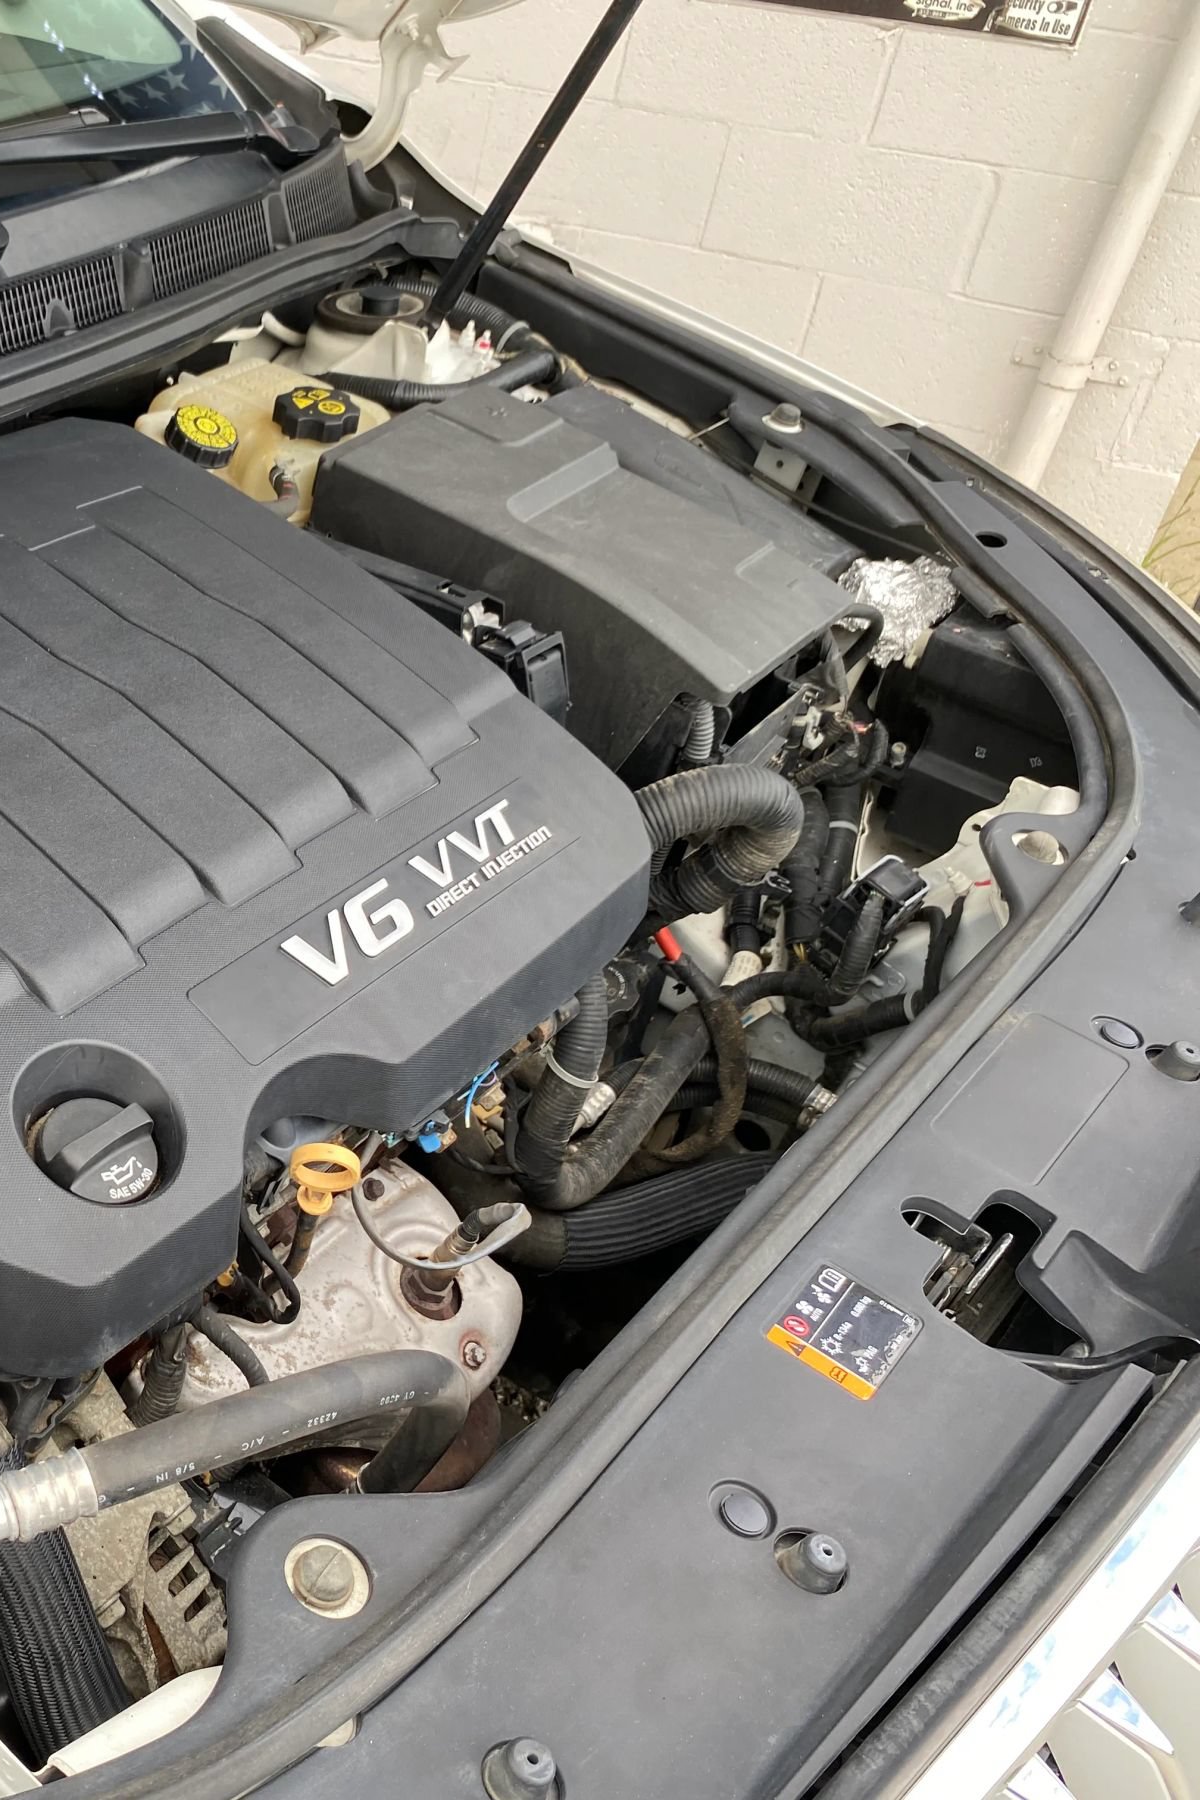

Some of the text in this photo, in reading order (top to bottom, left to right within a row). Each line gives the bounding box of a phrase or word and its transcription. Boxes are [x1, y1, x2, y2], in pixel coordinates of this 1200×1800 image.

[1039, 17, 1051, 33] In
[1051, 18, 1071, 35] Use
[425, 825, 553, 918] DIRECT INJECTION
[280, 798, 516, 986] V6 VVT
[109, 1167, 154, 1199] SAE 5W-30
[306, 1410, 338, 1428] 42332
[241, 1435, 265, 1451] A/C
[155, 1461, 196, 1483] 5/8 IN
